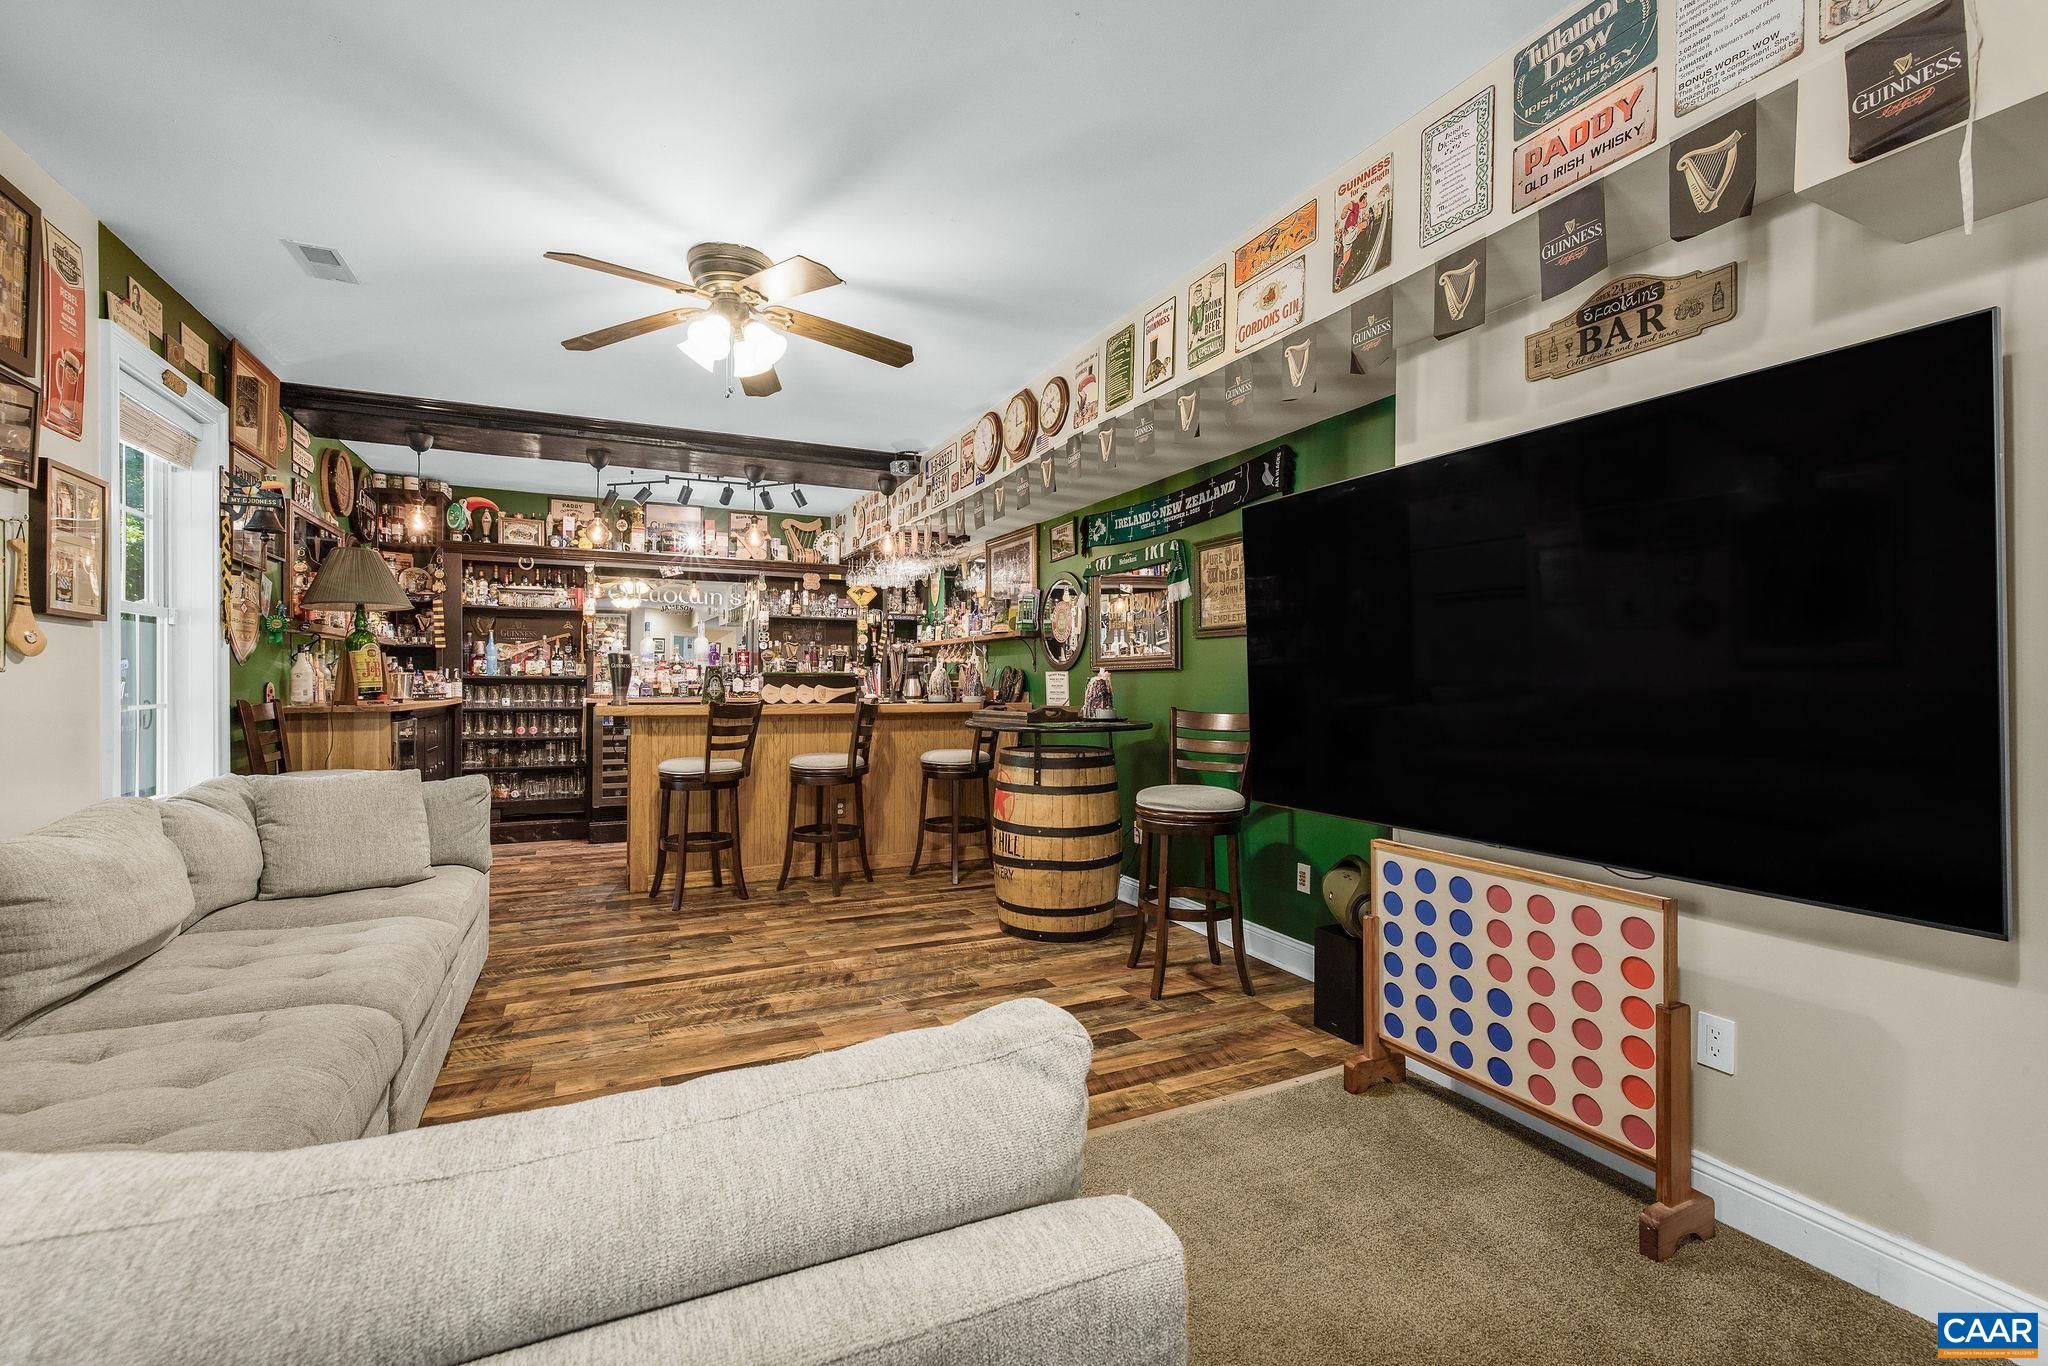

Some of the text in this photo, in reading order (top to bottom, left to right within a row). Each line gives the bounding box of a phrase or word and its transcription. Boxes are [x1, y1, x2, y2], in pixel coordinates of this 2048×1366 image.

[1679, 16, 1709, 38] 2.NOTHING
[1679, 34, 1692, 45] need
[1693, 34, 1711, 51] AHEAD
[1713, 27, 1724, 37] This
[1751, 5, 1762, 16] NOT
[1744, 28, 1755, 38] way
[1755, 23, 1762, 31] of
[1762, 13, 1781, 28] saying
[1541, 21, 1616, 86] Dew
[1678, 30, 1781, 91] BONUS WORD: WOW
[1678, 87, 1693, 98] This
[1694, 83, 1700, 91] is
[1701, 73, 1719, 87] NOT
[1726, 46, 1772, 73] compliment.
[1773, 31, 1797, 47] She's
[1687, 51, 1698, 61] NOT
[1698, 45, 1705, 53] do
[1524, 48, 1634, 119] IRISH WHISKEY
[1550, 52, 1607, 91] FINEST OLD
[1678, 37, 1799, 105] amazed that one person could be
[1851, 51, 1963, 115] GUINNESS
[1524, 84, 1645, 177] PADDY
[1524, 122, 1645, 195] OLD IRISH WHISKY
[1337, 156, 1391, 197] GUINNESS
[1350, 168, 1390, 198] for strength
[1541, 222, 1603, 260] GUINNESS
[60, 286, 79, 307] REBEL
[1204, 297, 1222, 313] DRINK
[1612, 284, 1626, 298] 24
[62, 301, 76, 316] RED
[1204, 307, 1222, 324] MORE
[1237, 298, 1300, 343] GORDON'S GIN
[1204, 319, 1220, 335] BEER
[1352, 320, 1391, 345] GUINNESS
[1576, 303, 1667, 358] BAR
[1566, 328, 1681, 370] Cold drinks and good times
[1225, 382, 1253, 401] GUINNESS
[1114, 479, 1237, 530] IRELAND NEW ZEALAND
[1220, 584, 1238, 596] JOHN
[660, 605, 695, 613] JAMESON
[500, 630, 539, 638] GUINNESS
